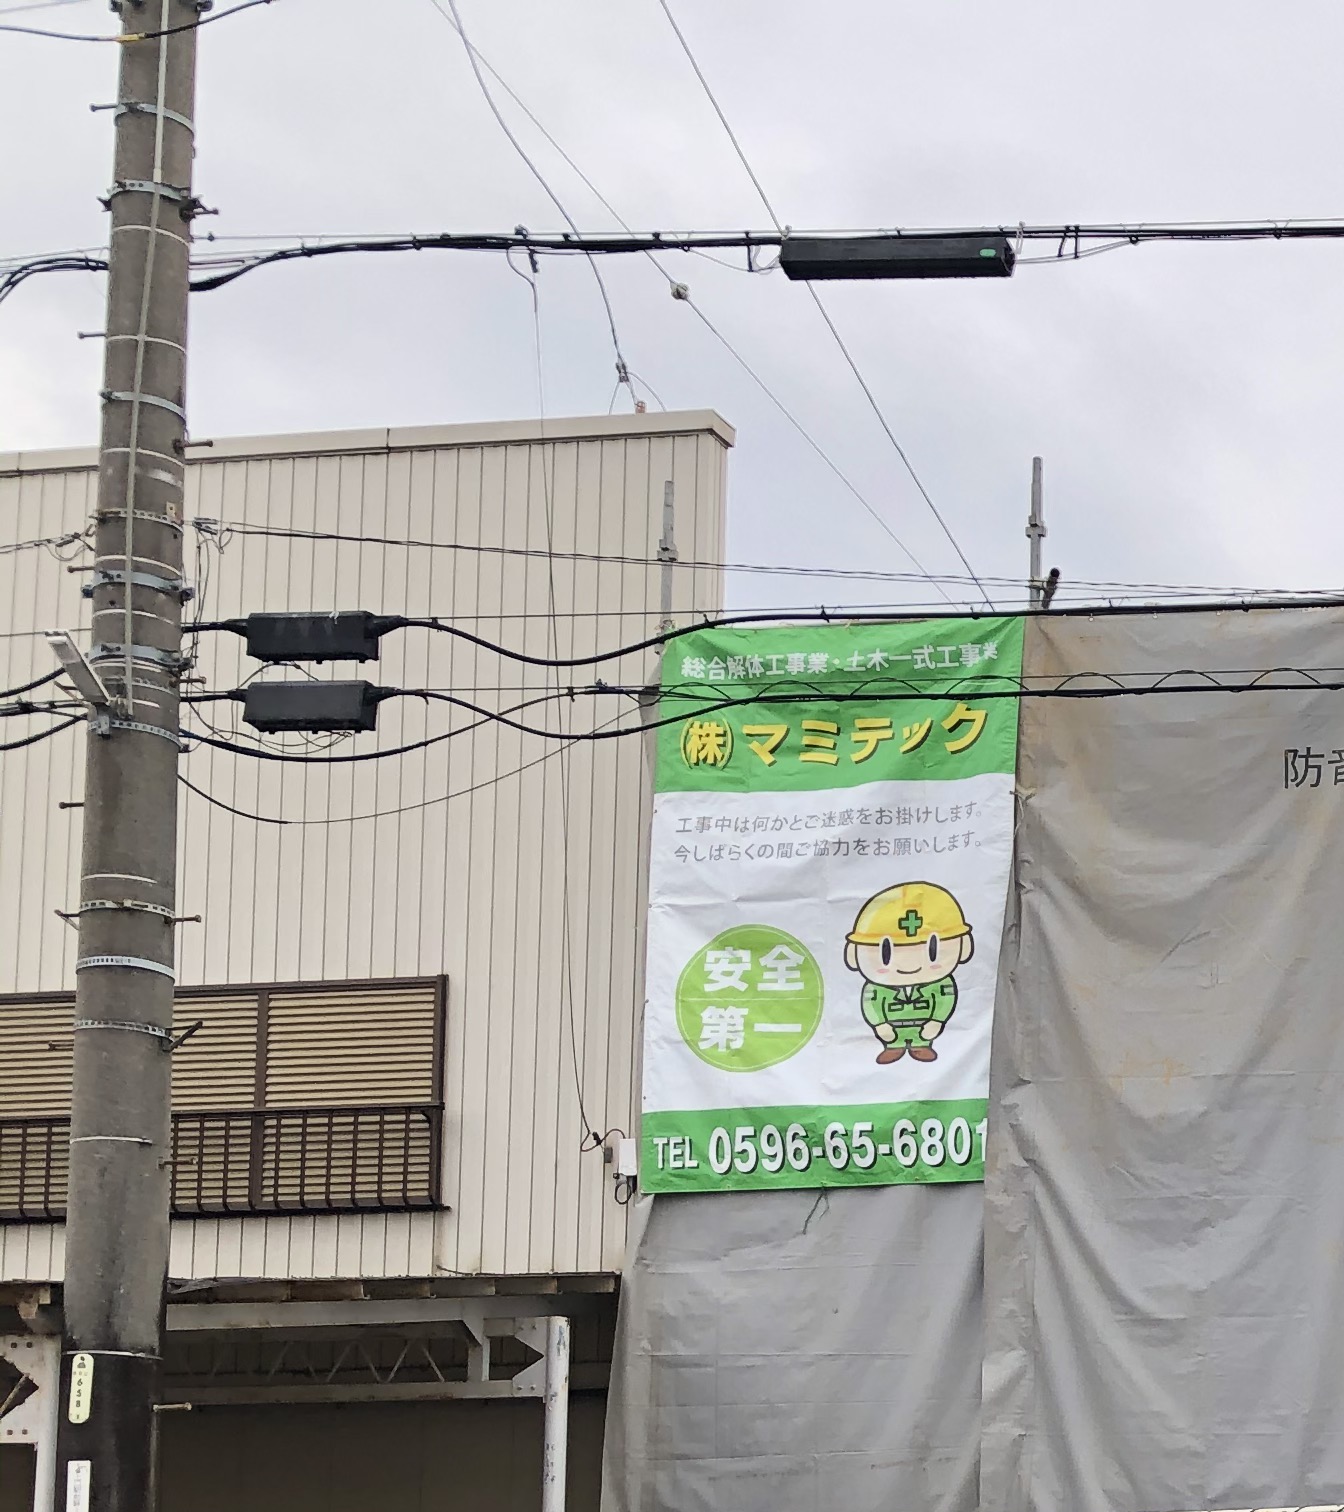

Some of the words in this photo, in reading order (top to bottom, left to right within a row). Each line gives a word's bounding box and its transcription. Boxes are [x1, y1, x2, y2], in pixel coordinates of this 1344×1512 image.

[675, 801, 982, 834] 工事中は何かとご迷惑をお掛けします。
[674, 830, 982, 864] 今しばらくの間ご協力をお願いします。
[703, 944, 805, 993] 安全
[698, 1005, 802, 1052] 第一
[653, 1135, 698, 1168] TEL
[708, 1117, 988, 1174] 0596-65-6801
